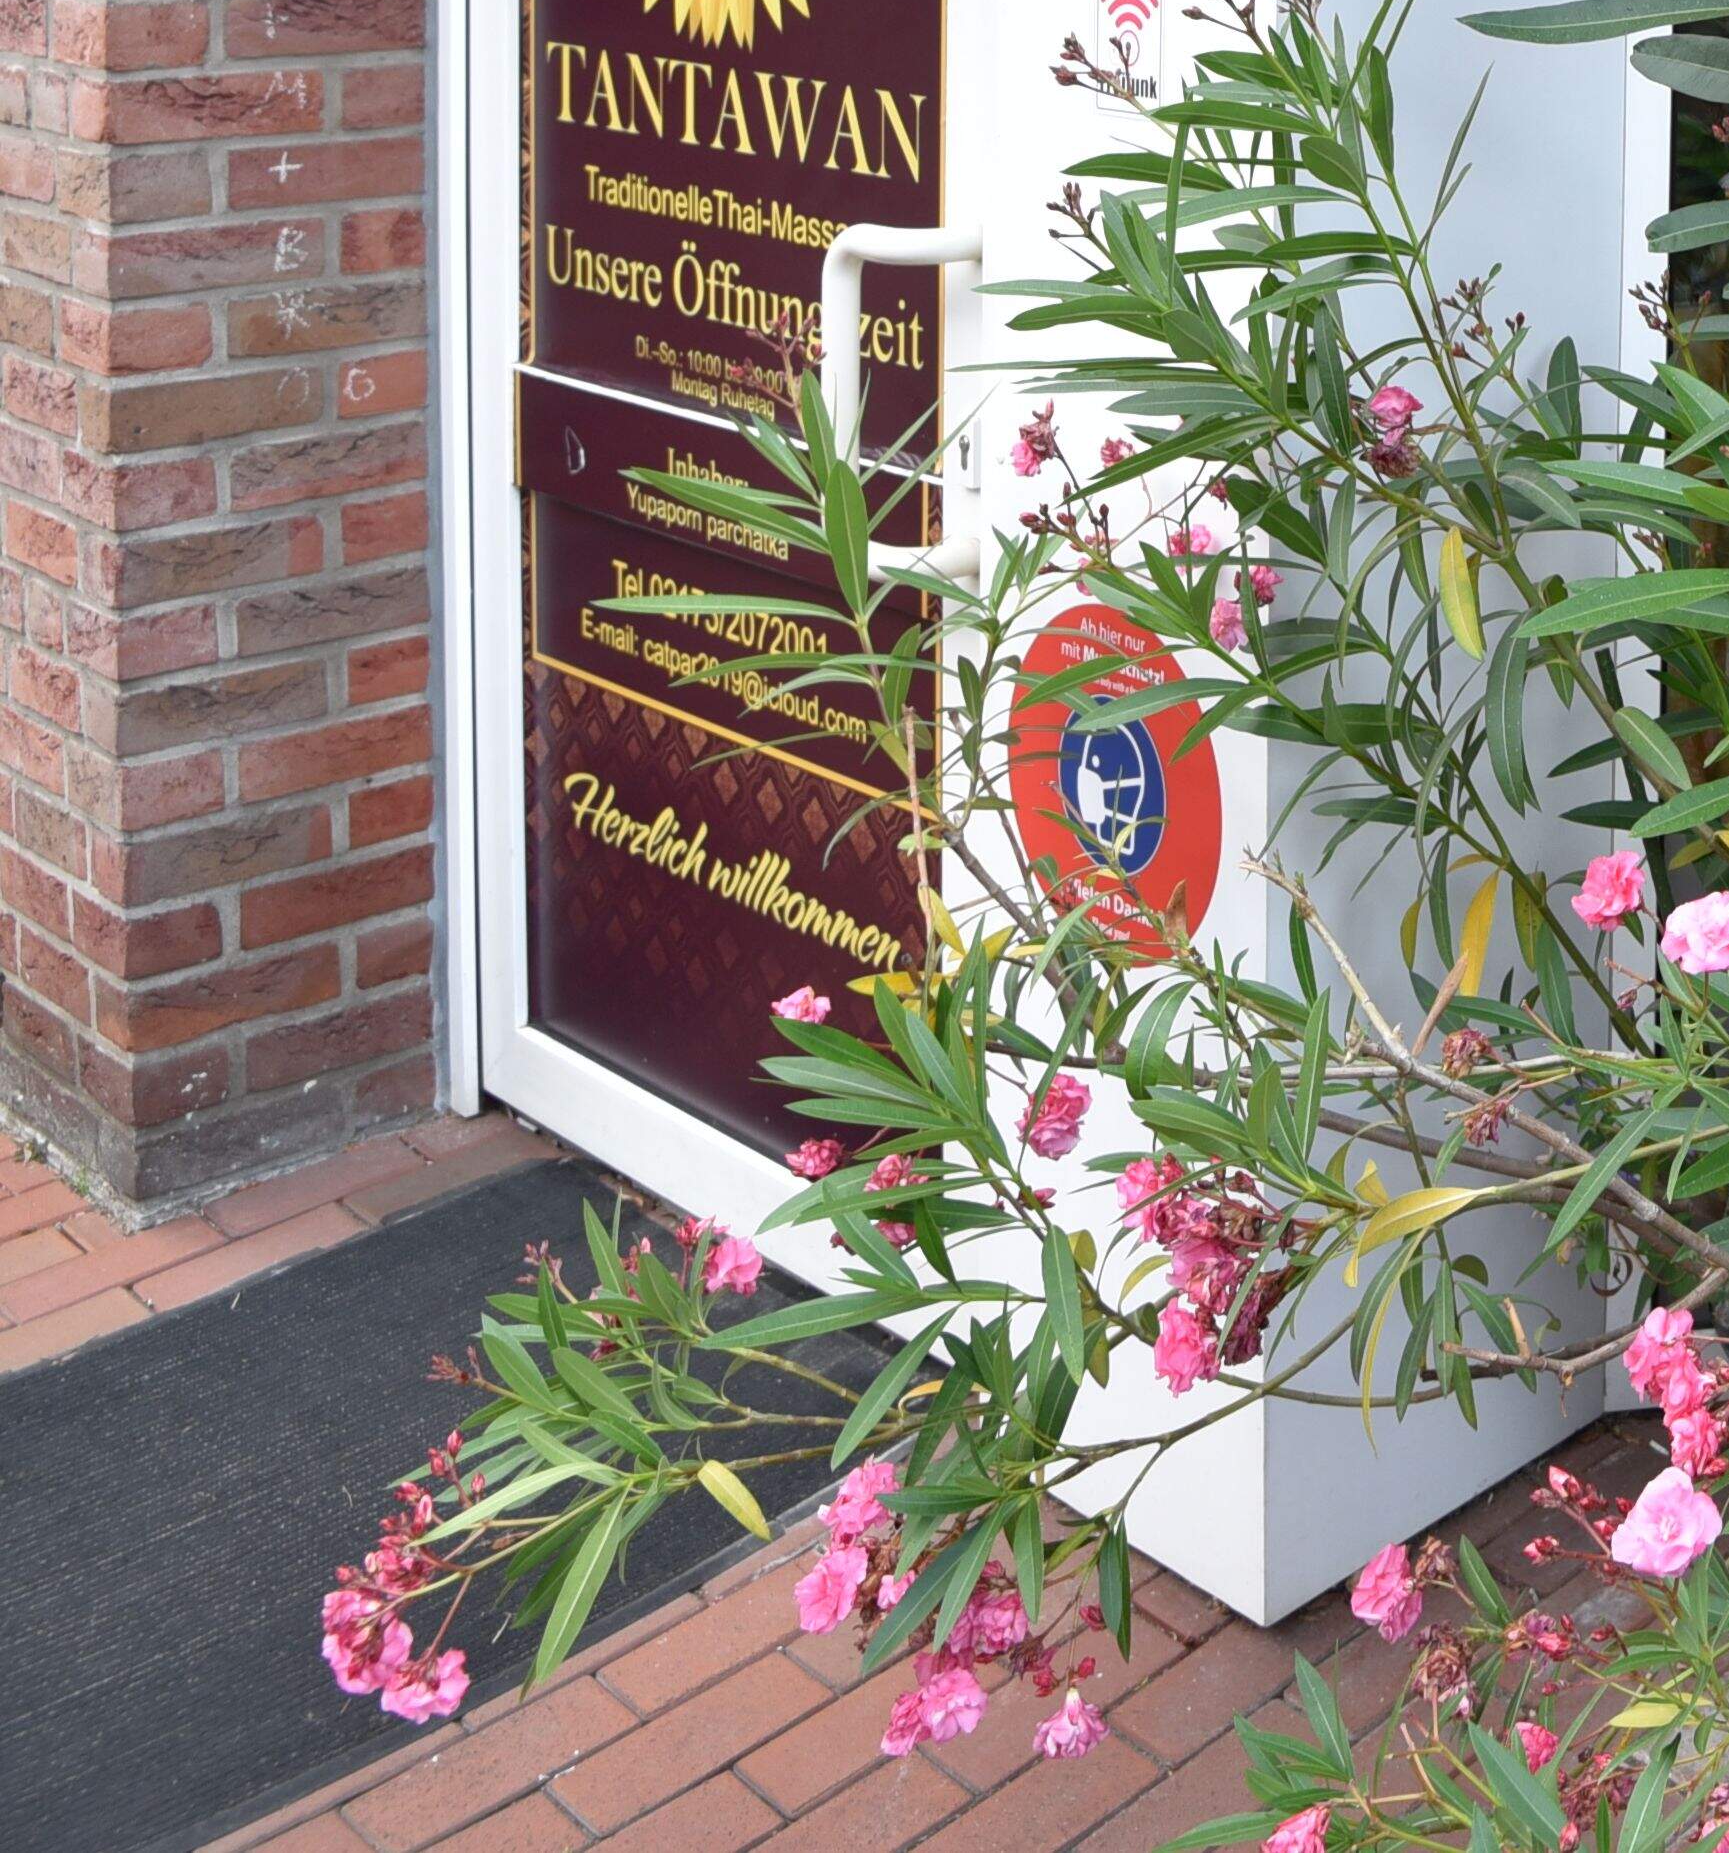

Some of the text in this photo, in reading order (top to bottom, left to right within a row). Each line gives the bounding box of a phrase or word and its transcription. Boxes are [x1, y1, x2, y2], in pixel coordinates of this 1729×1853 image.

[547, 41, 927, 183] TANTAWAN
[546, 224, 923, 370] Unsere Öffnungzeit
[687, 350, 721, 377] 10:00
[672, 369, 718, 408] Montag
[721, 383, 775, 423] Ruhetag
[627, 482, 702, 532] Yupaporn
[581, 608, 639, 657] E-mail:
[1061, 642, 1080, 660] mit
[1080, 617, 1145, 652] Ab hier nur
[563, 772, 903, 970] Herzlich willkommen
